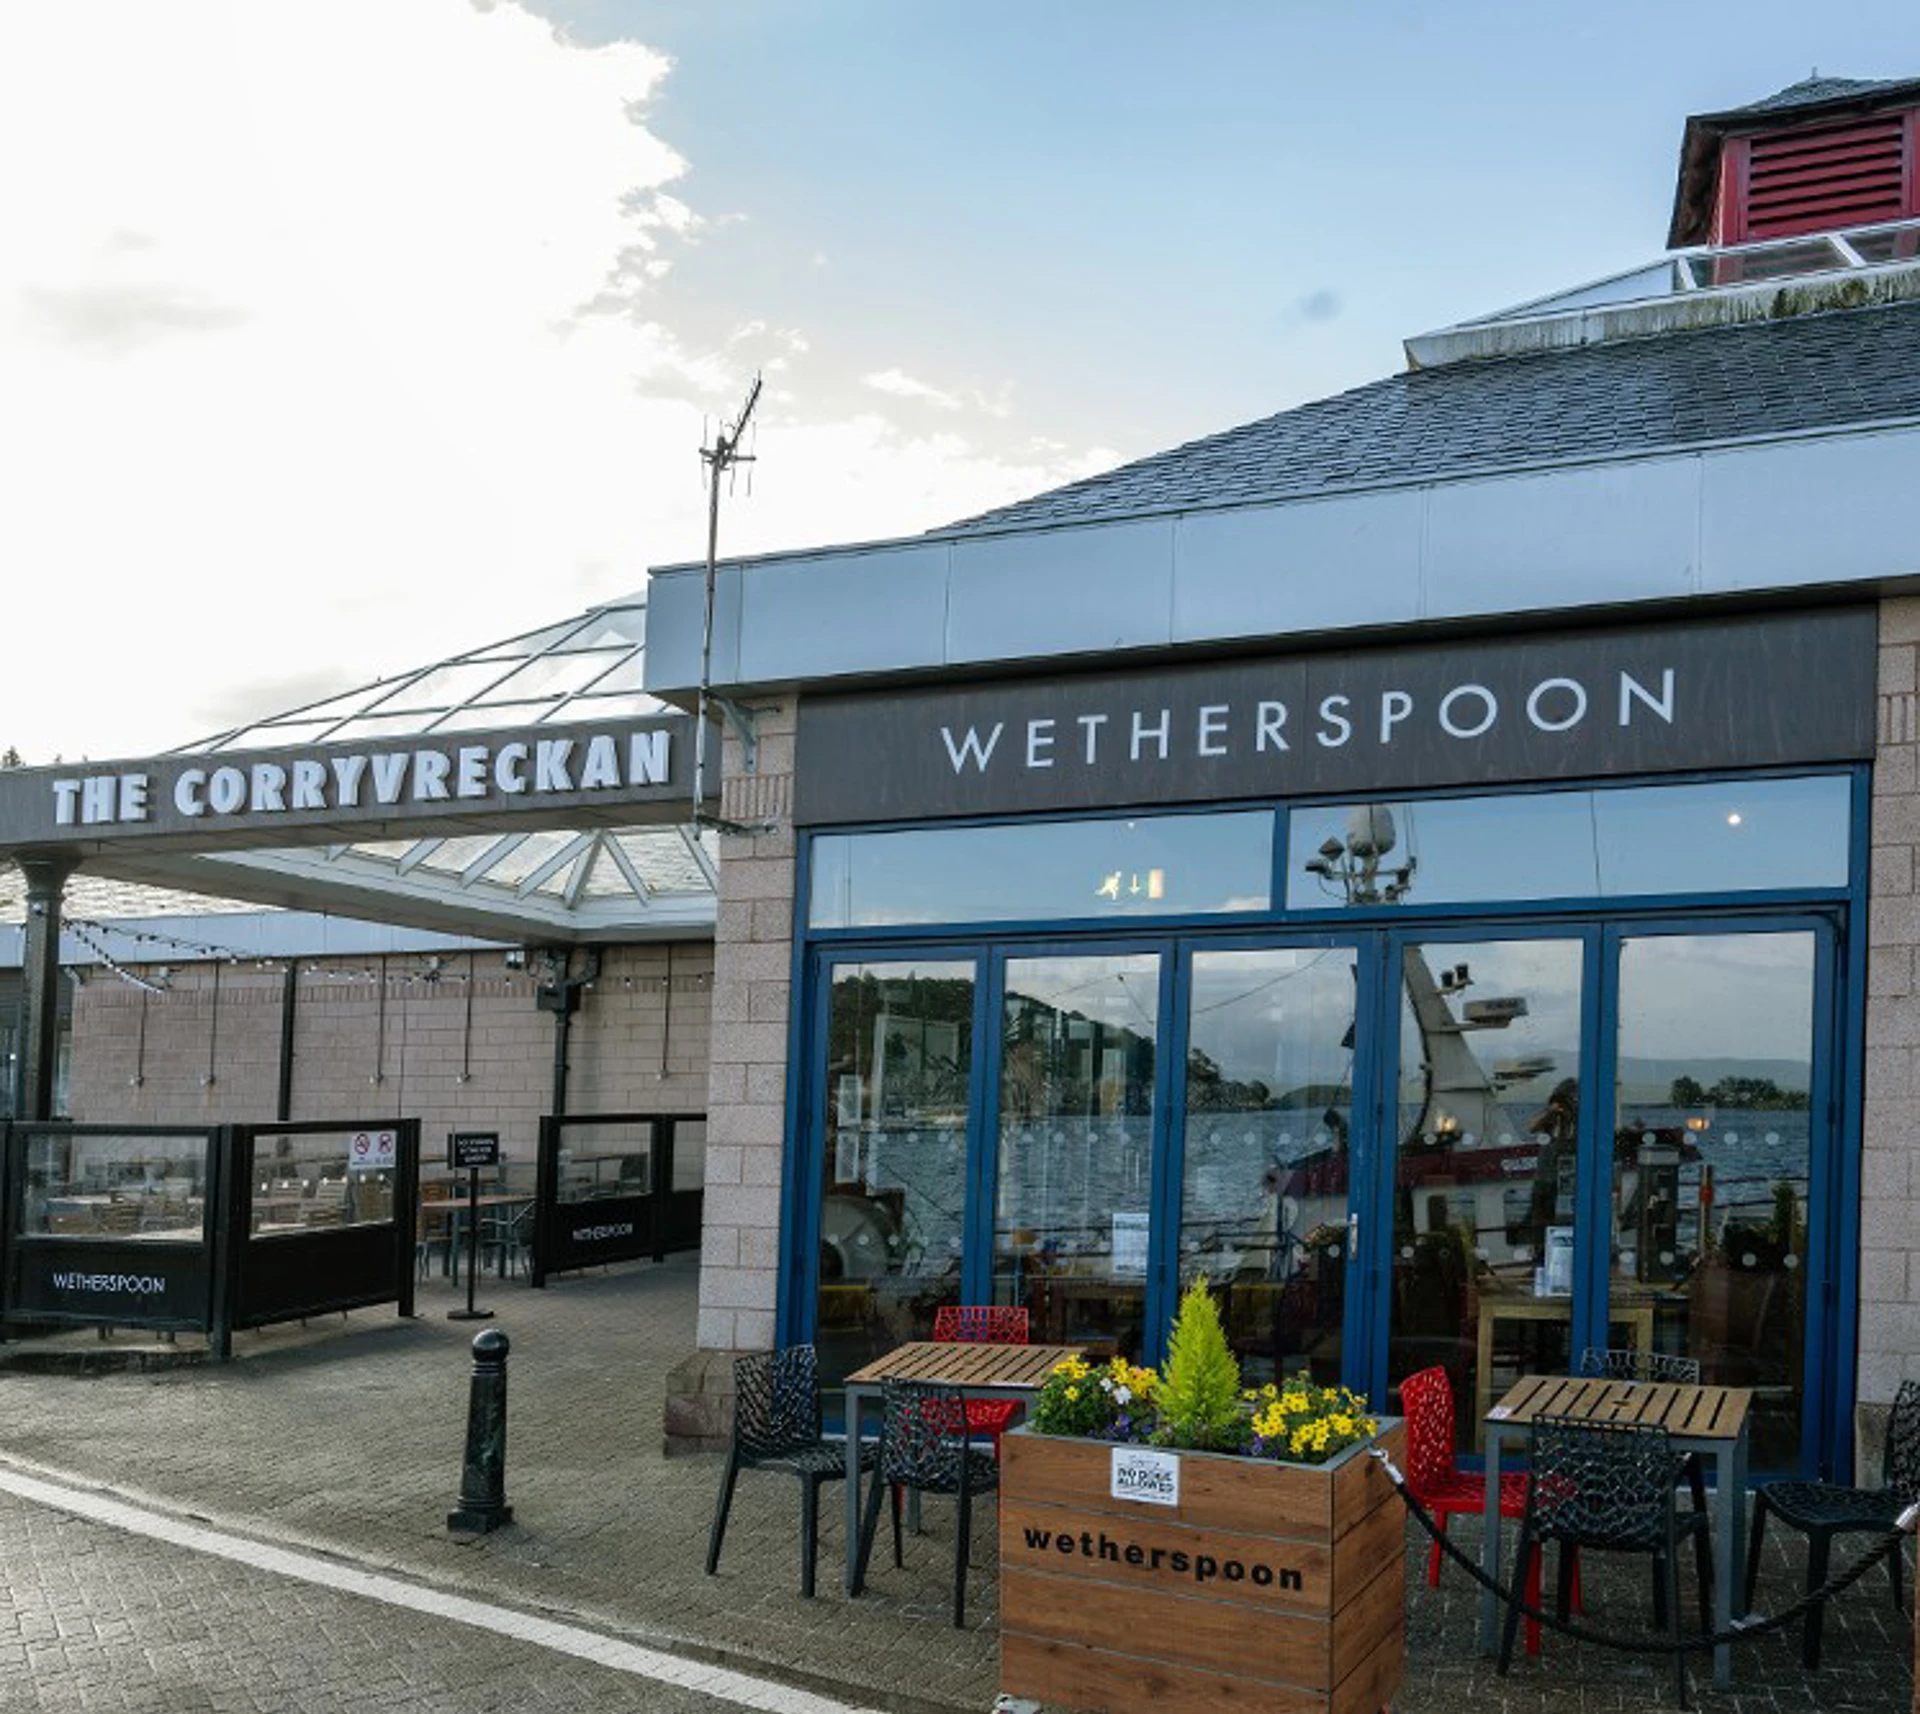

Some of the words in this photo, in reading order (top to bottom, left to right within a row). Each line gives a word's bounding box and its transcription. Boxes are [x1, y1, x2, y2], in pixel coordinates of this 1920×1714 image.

[941, 668, 1676, 774] WETHERSPOON
[53, 774, 149, 824] THE
[174, 730, 671, 817] CORRYVRECKAN
[53, 1272, 166, 1294] WETHERSPOON
[1138, 1470, 1173, 1482] DS
[1023, 1527, 1303, 1591] wetherspoon
